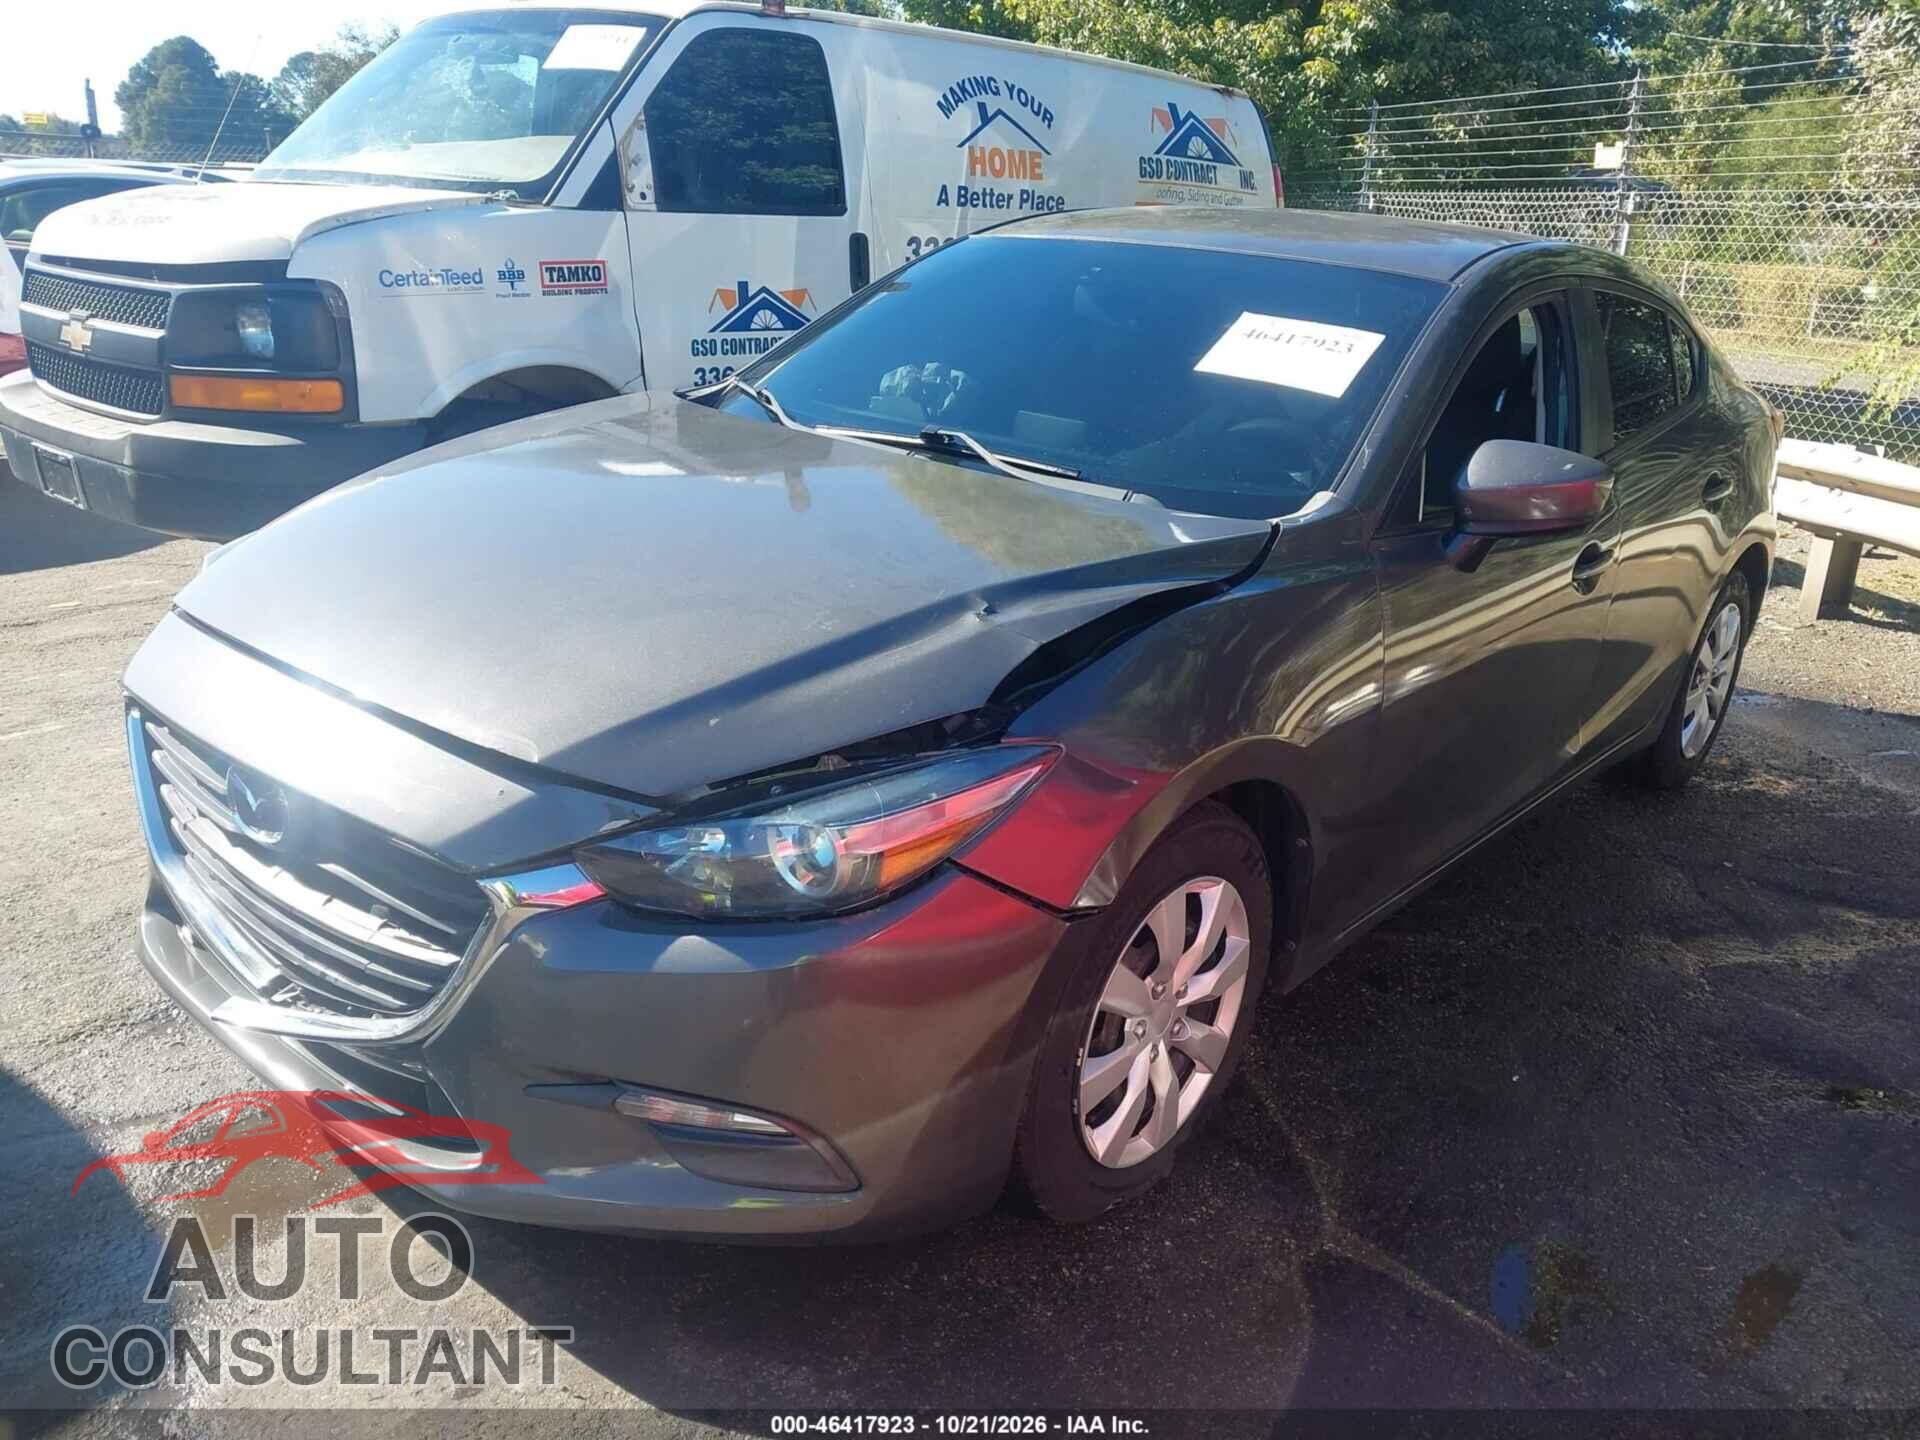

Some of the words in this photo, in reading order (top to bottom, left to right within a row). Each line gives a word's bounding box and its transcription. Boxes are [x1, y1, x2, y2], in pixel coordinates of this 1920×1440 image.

[936, 75, 1001, 120] MAKING
[1003, 80, 1054, 130] YOUR
[968, 146, 1043, 181] HOME
[1166, 158, 1218, 186] CONTRACT
[936, 184, 950, 207] A
[956, 185, 1013, 210] Better
[1019, 189, 1065, 212] Place
[379, 267, 483, 288] CertainTeed
[497, 269, 525, 281] BBB
[545, 265, 602, 283] TAMKO
[542, 288, 573, 297] BUILDING
[575, 287, 608, 296] PRODUCTS
[691, 338, 717, 357] GSO
